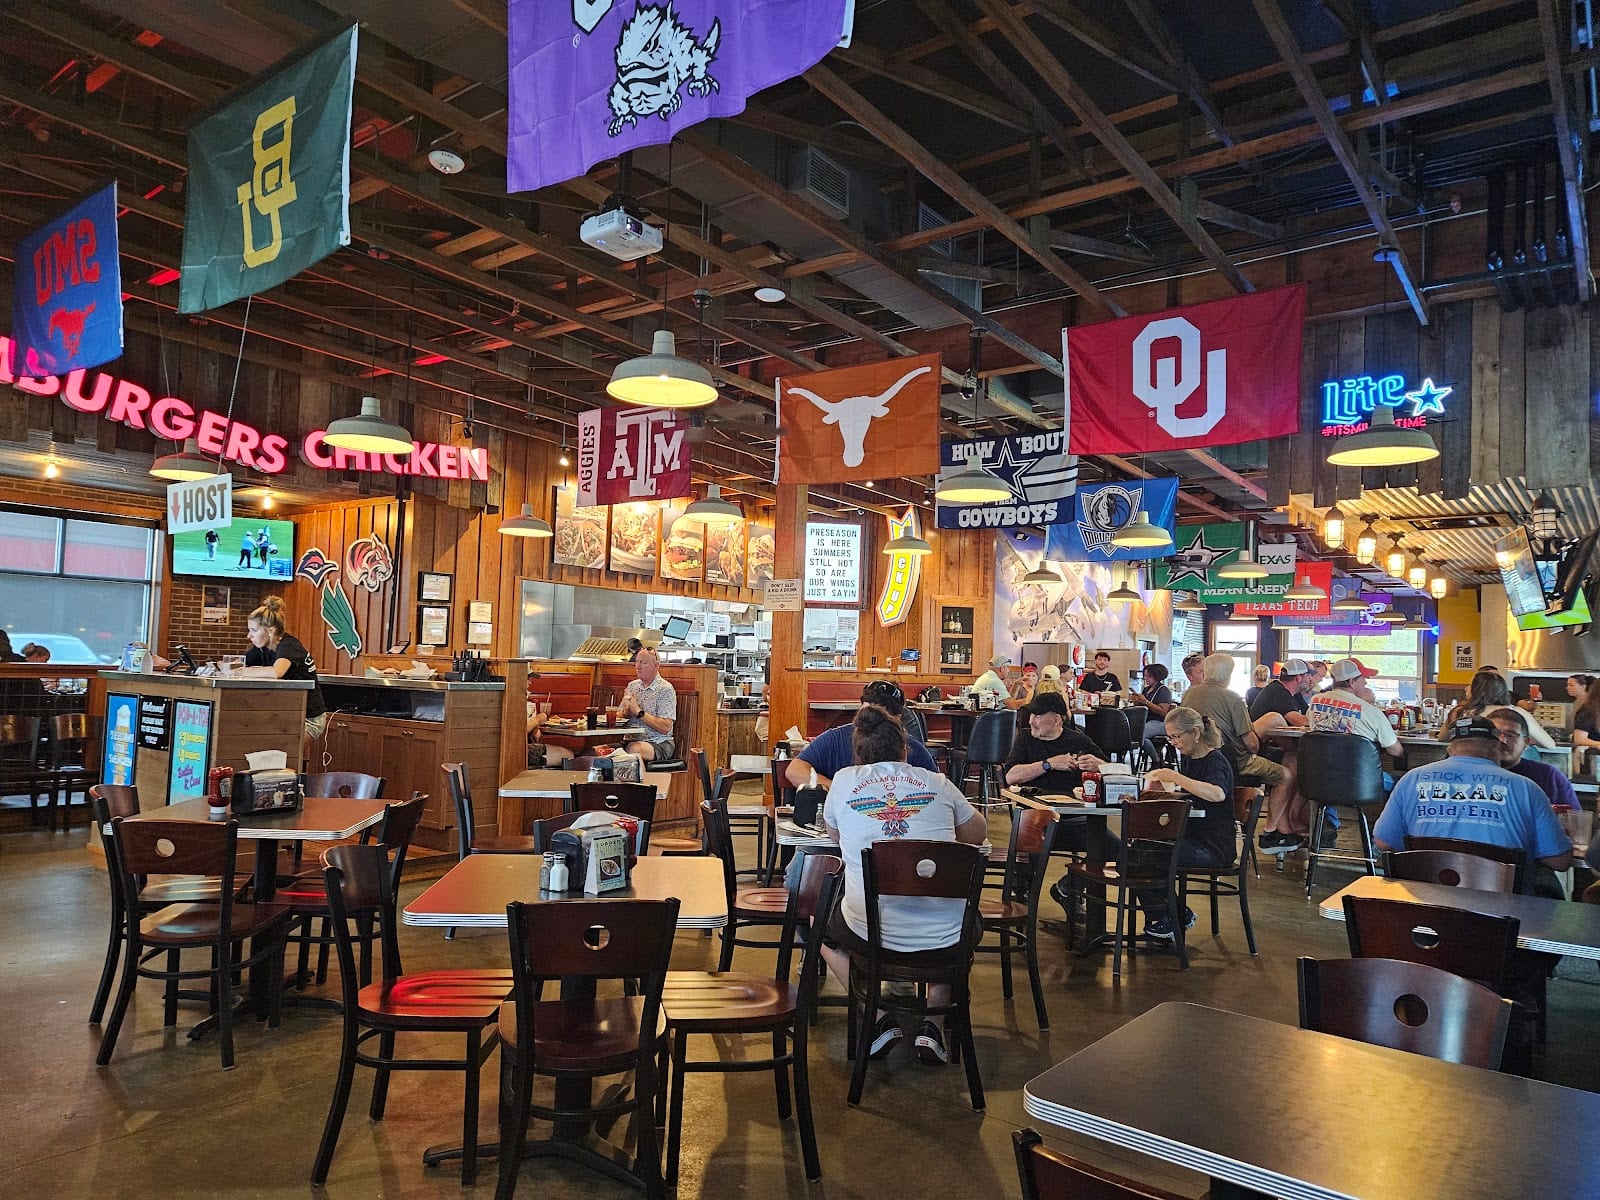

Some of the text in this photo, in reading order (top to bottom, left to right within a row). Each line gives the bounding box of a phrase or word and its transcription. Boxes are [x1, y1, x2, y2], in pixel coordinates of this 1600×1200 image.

[1133, 316, 1227, 438] OU
[1322, 374, 1407, 425] Lite
[303, 430, 489, 481] CHICKEN
[951, 440, 996, 462] HOW
[581, 424, 596, 493] AGGIES
[183, 482, 228, 524] HOST
[958, 502, 1058, 528] COWBOYS
[810, 528, 857, 538] PRESEASON
[831, 539, 852, 547] HERE
[813, 548, 852, 557] SUMMERS
[809, 558, 854, 567] STILL HOT
[1259, 555, 1292, 564] EXAS
[816, 568, 847, 577] SO ARE
[809, 578, 855, 587] OUR WINGS
[806, 588, 857, 597] JUST SAYIN
[1245, 584, 1290, 595] GREEN
[1245, 600, 1319, 611] TEXAS TECH
[1422, 771, 1465, 782] STICK
[1471, 773, 1510, 785] WITH
[852, 776, 889, 795] MAGELLAN
[1415, 781, 1508, 805] TEXAS
[1416, 804, 1457, 817] Hold
